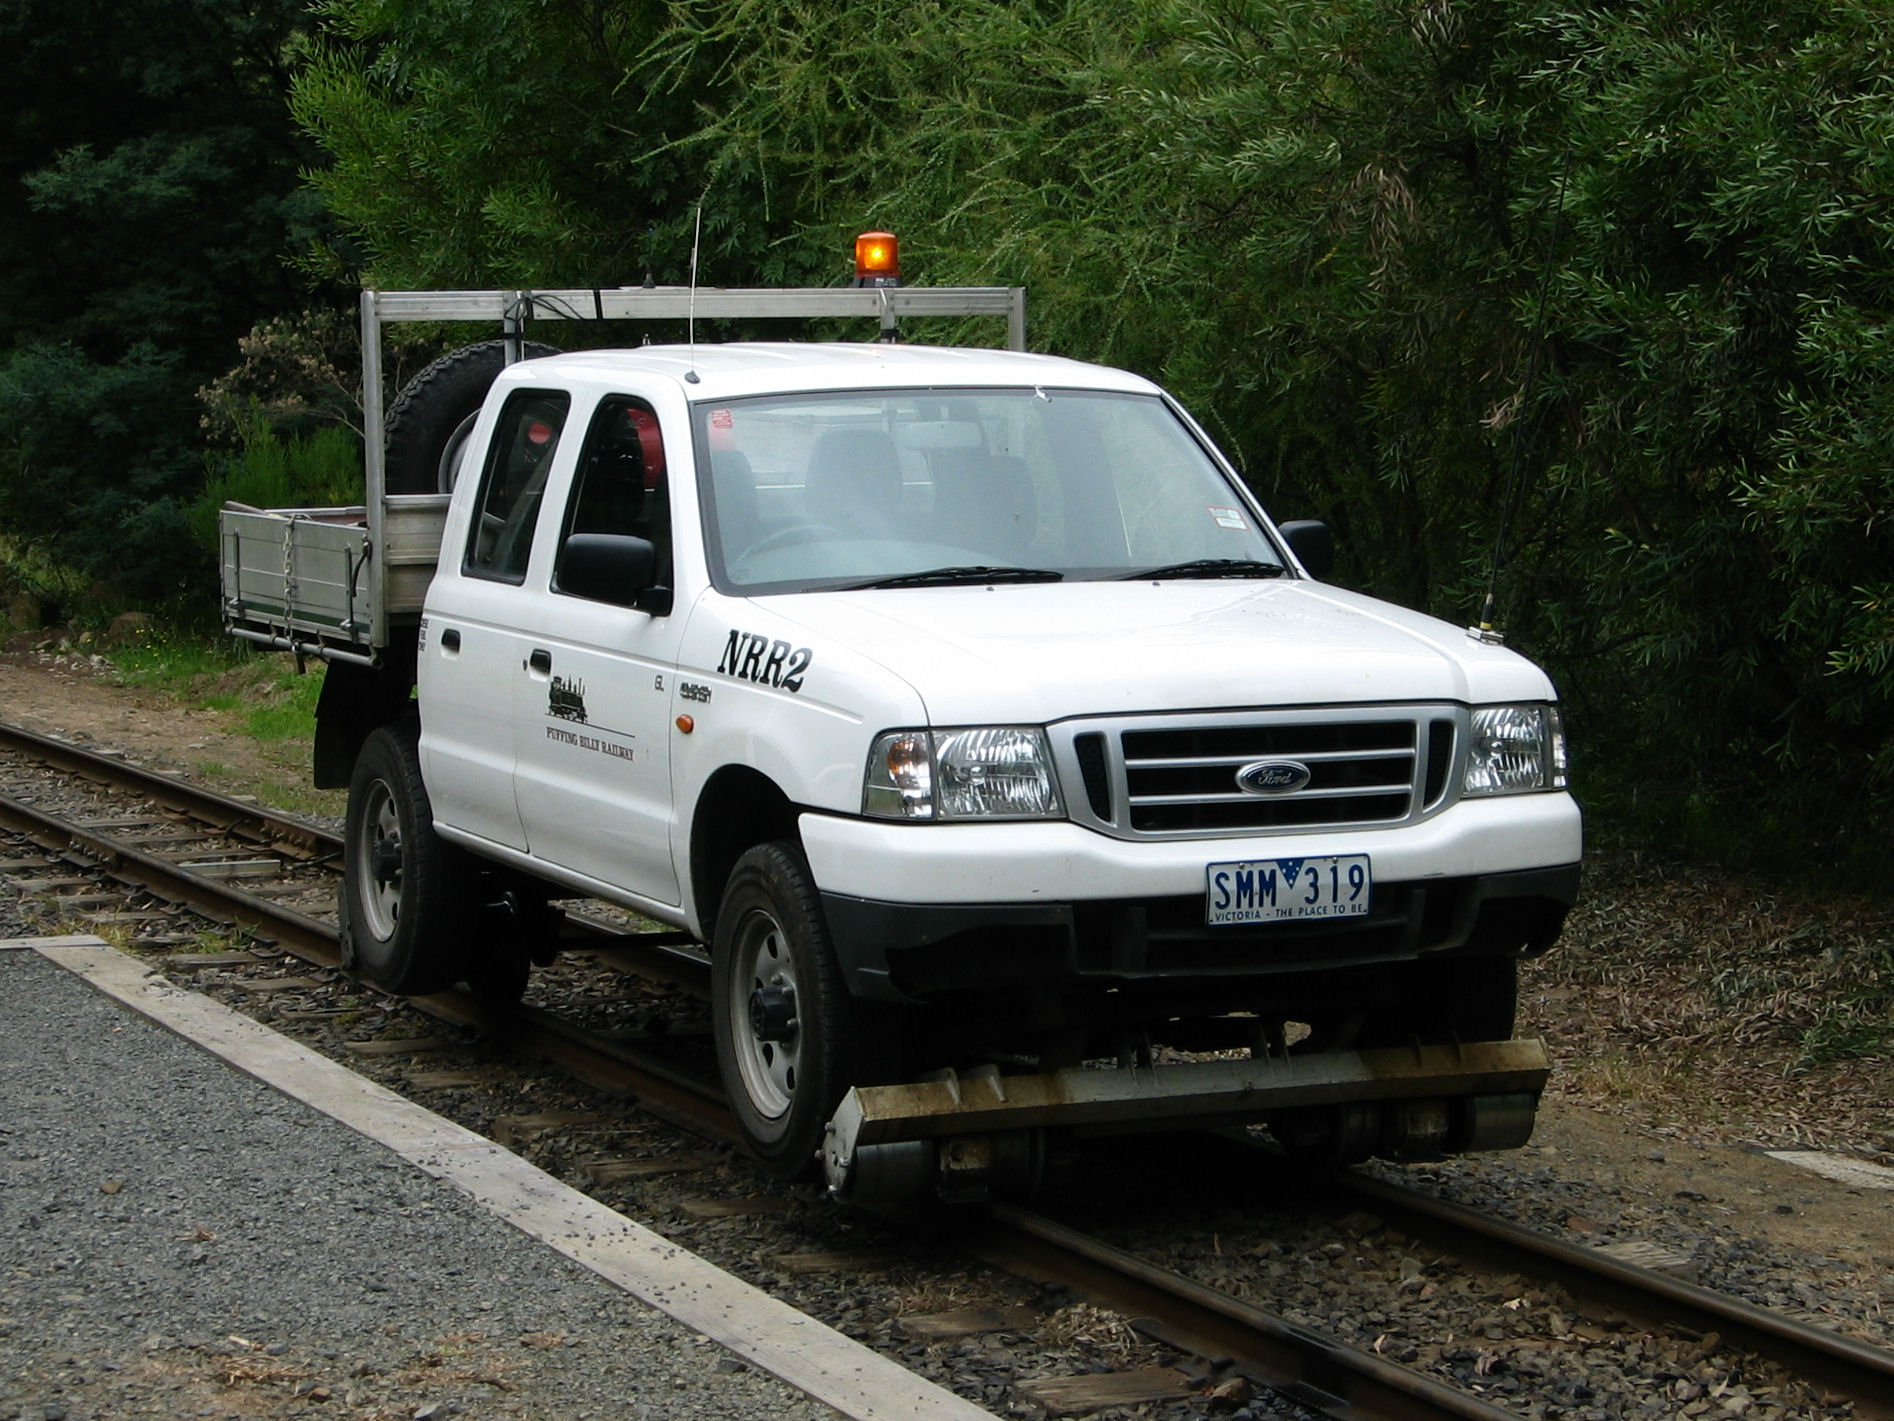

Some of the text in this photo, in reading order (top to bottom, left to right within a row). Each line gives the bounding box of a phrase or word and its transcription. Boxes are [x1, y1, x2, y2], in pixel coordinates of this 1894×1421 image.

[717, 629, 813, 693] NRR2
[547, 726, 634, 761] PUFFING BILLY RAILWAY
[1258, 768, 1292, 785] Ford
[1215, 864, 1365, 910] SMM 319
[1215, 910, 1261, 922] VICTORIA
[1276, 908, 1293, 918] THE
[1299, 905, 1328, 916] PLACE
[1333, 905, 1346, 914] TO
